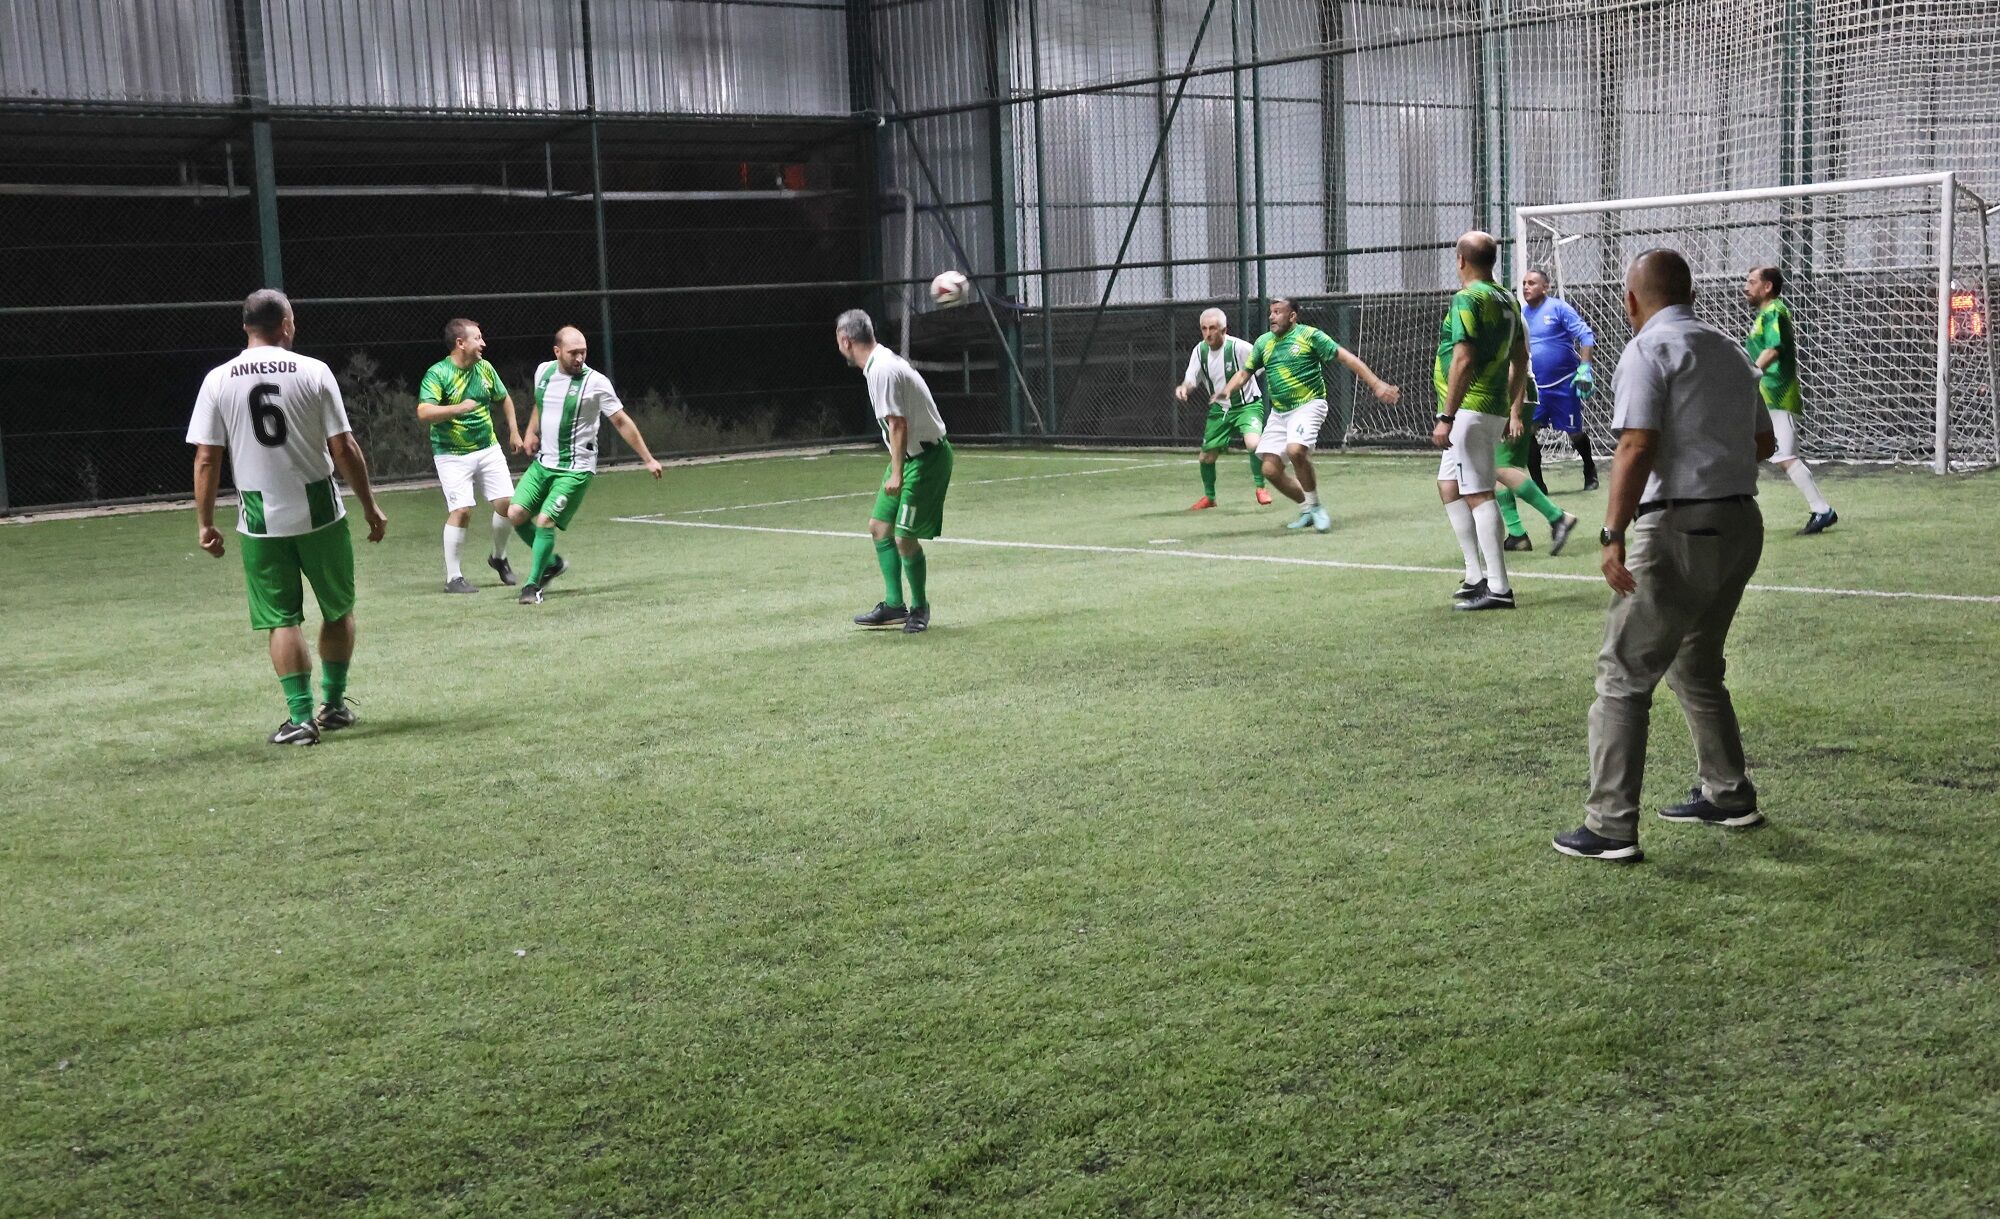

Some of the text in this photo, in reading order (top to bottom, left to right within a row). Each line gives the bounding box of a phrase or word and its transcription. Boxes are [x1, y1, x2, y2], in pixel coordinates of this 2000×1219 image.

[1502, 308, 1516, 360] 7
[230, 360, 298, 378] ANKESOB
[247, 382, 288, 449] 6
[1568, 414, 1574, 426] 1
[1296, 423, 1304, 436] 4
[900, 503, 917, 528] 11
